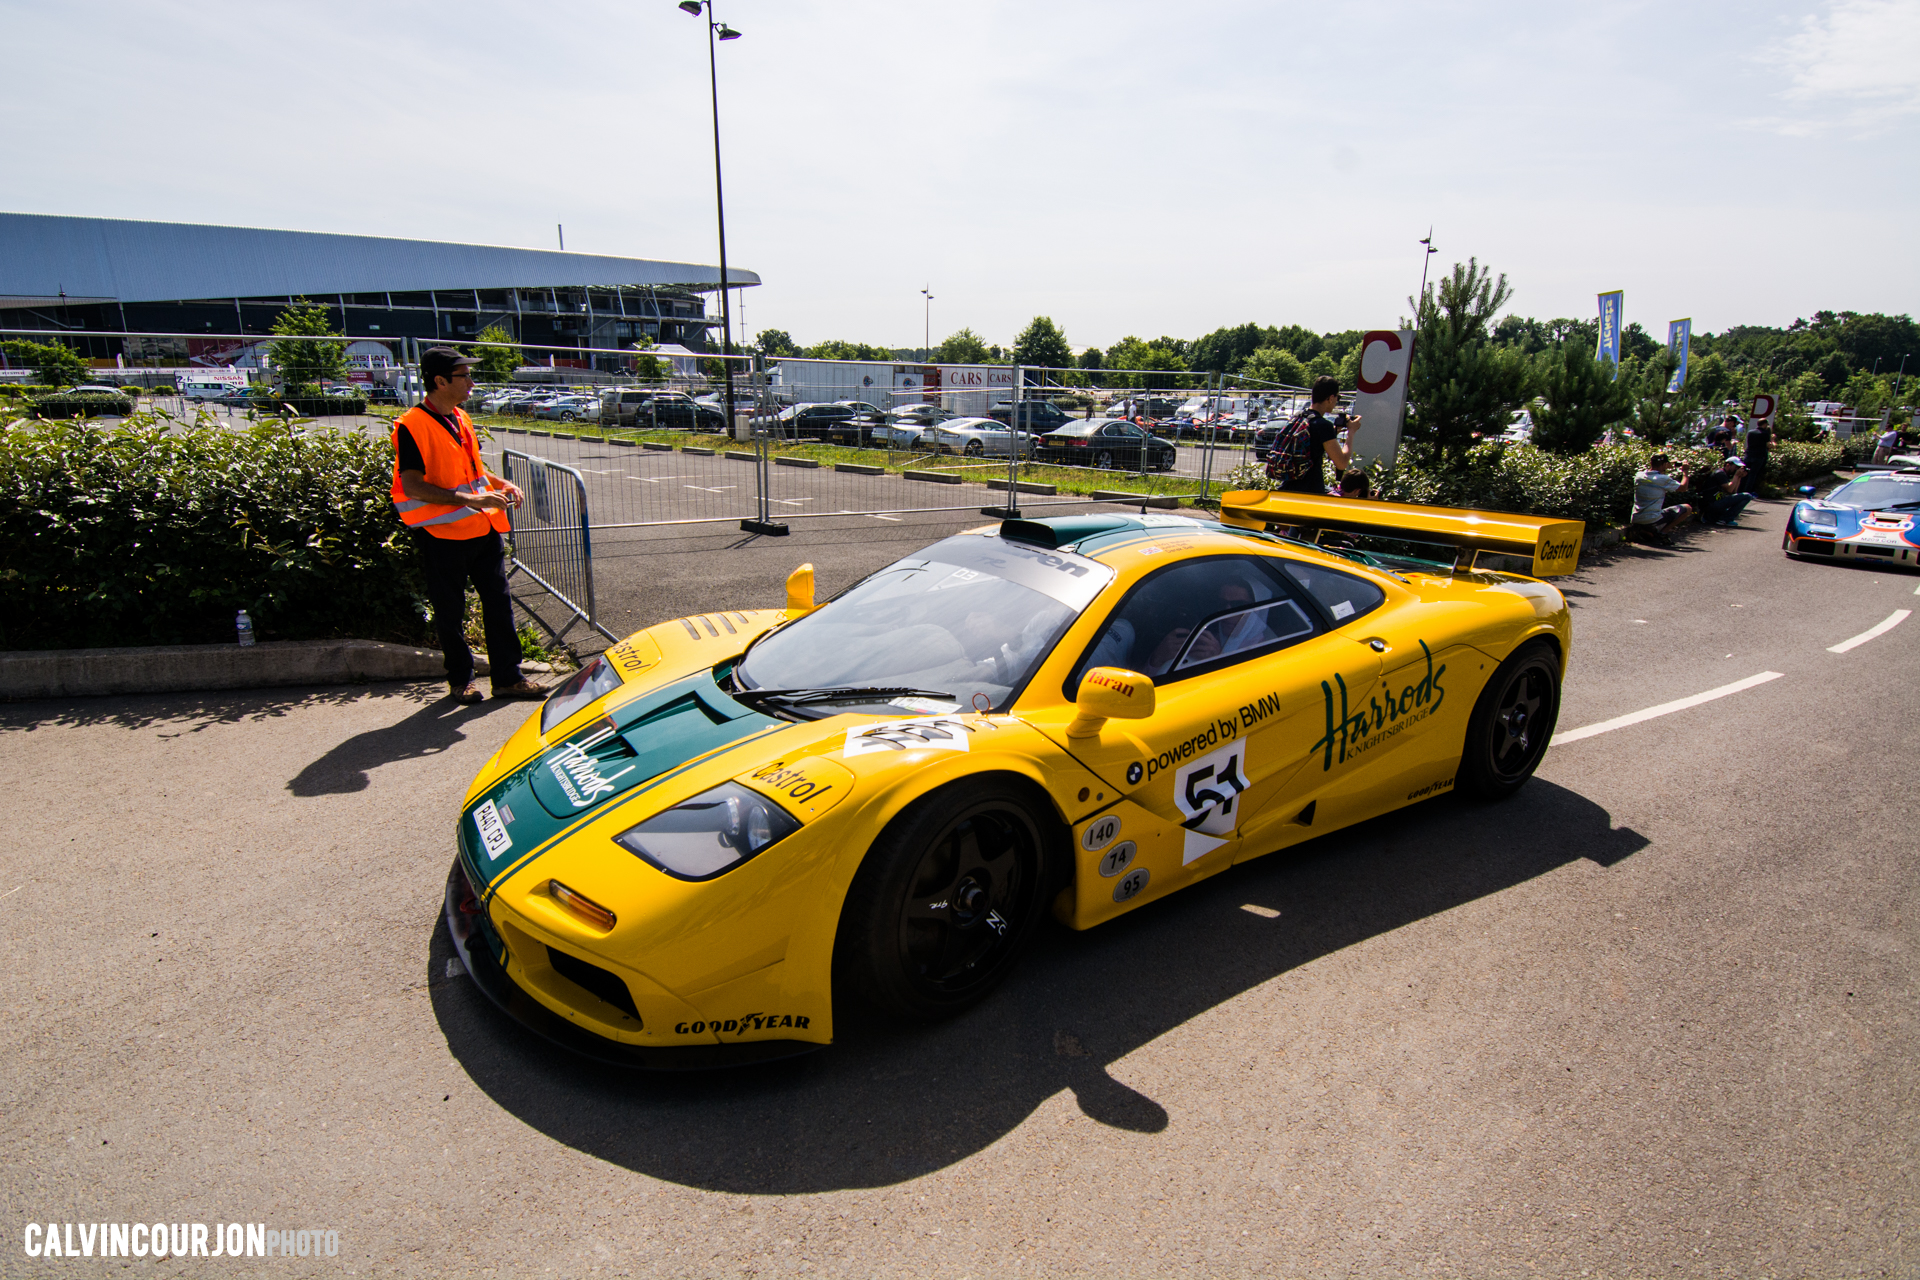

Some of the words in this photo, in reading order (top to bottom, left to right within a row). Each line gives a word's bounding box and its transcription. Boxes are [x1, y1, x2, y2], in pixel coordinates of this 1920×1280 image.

[1356, 331, 1403, 394] C
[950, 371, 982, 385] CARS
[989, 373, 1012, 383] CARS
[1750, 395, 1775, 418] D
[1839, 407, 1854, 422] E
[1541, 539, 1578, 561] Castrol
[1087, 671, 1135, 698] Taran
[1310, 638, 1446, 772] Harrods
[1147, 723, 1218, 782] powered
[1217, 716, 1237, 740] by
[1238, 691, 1281, 728] BMW
[1346, 706, 1430, 761] KNIGHTSBRIDGE
[546, 725, 637, 807] Harrods
[751, 761, 833, 805] Castrol
[1180, 753, 1245, 830] 51
[1407, 777, 1454, 801] GOODYEAR
[477, 804, 497, 832] P440
[486, 828, 507, 852] CPJ
[1088, 821, 1115, 846] 140
[1109, 847, 1127, 870] 74
[1123, 874, 1140, 896] 95
[674, 1012, 811, 1035] GOODYEAR
